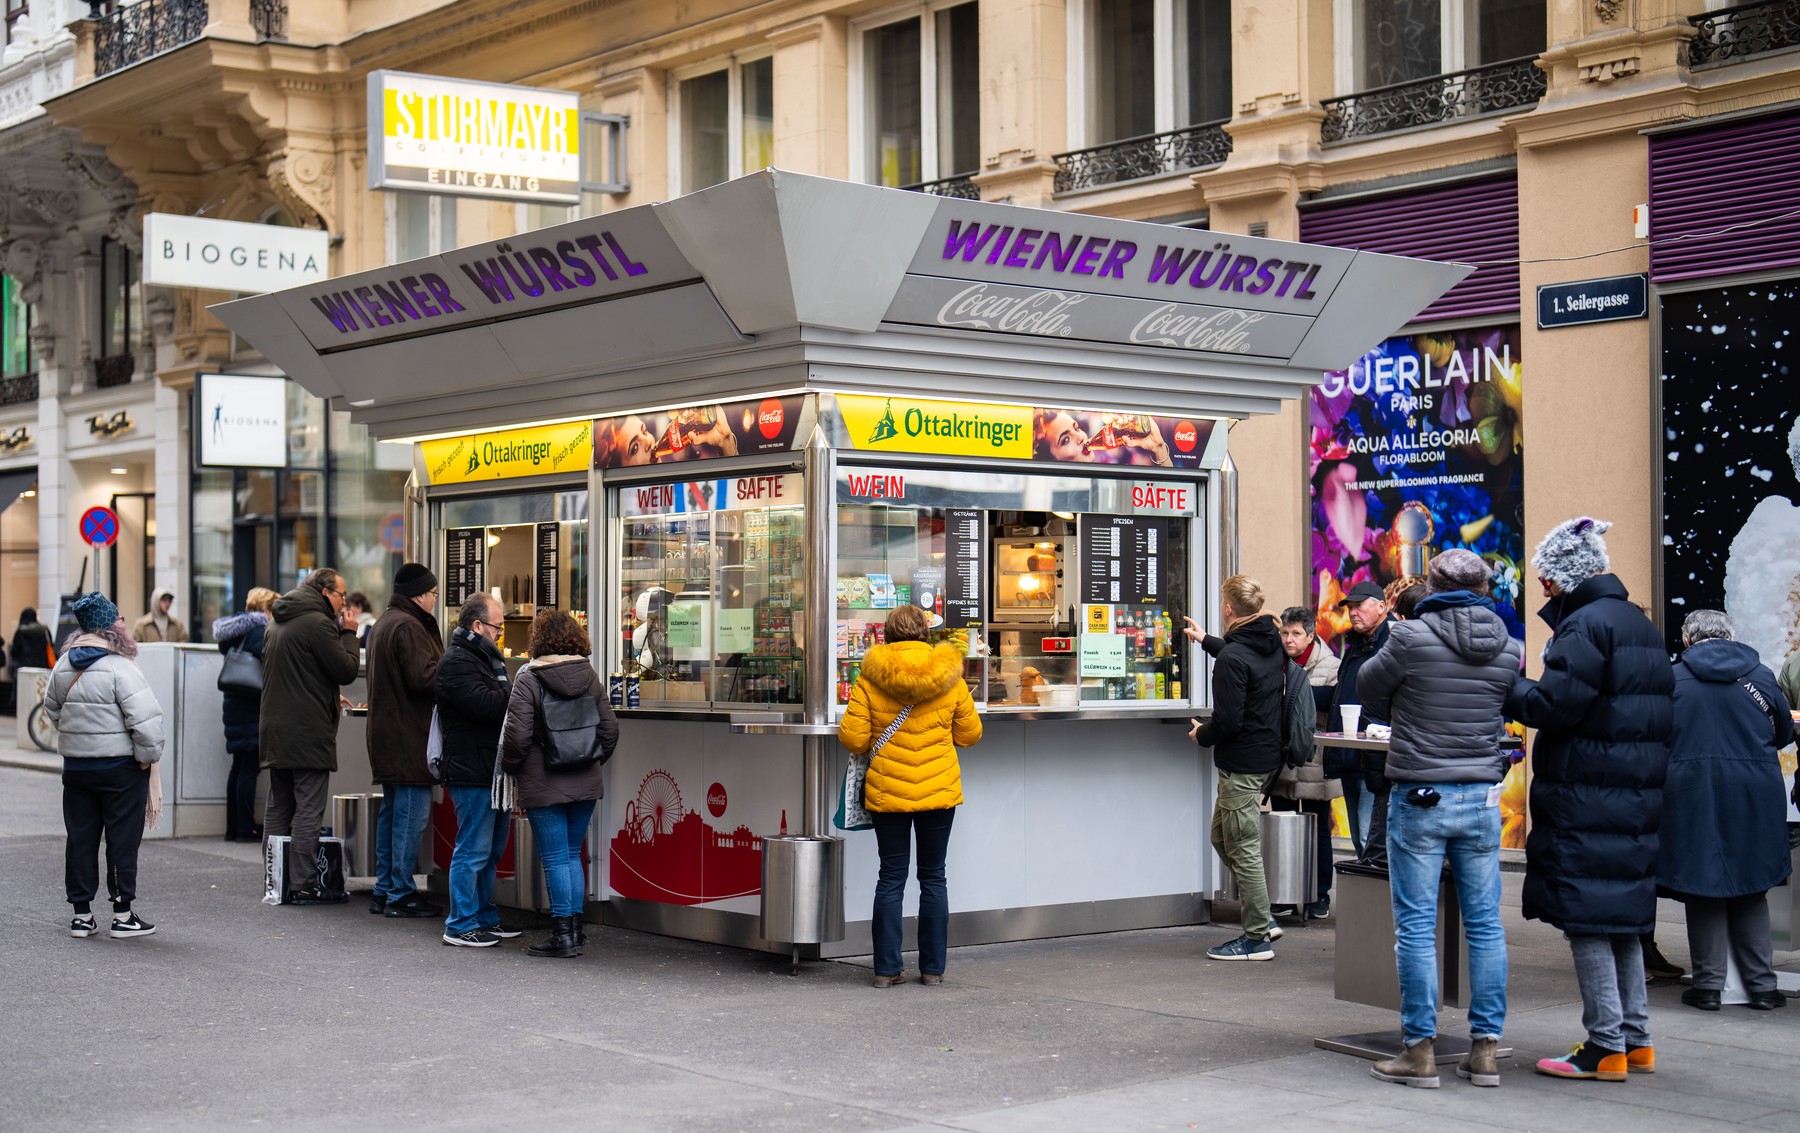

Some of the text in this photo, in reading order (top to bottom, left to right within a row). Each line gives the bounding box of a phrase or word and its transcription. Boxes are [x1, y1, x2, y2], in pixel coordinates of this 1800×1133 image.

[396, 90, 568, 154] STURMAYR
[428, 169, 540, 192] EINGANG
[164, 240, 318, 273] BIOGENA
[942, 218, 1322, 300] WIENER WÜRSTL
[310, 231, 648, 333] WIENER WÜRSTL
[1566, 292, 1629, 312] Seilergasse
[1320, 344, 1511, 398] GUERLAIN
[1390, 394, 1433, 412] PARIS
[904, 407, 1023, 446] Ottakringer
[1347, 428, 1481, 454] AQUA ALLEGORIA
[483, 439, 552, 468] Ottakringer
[1379, 450, 1446, 465] FLORABLOOM
[849, 474, 1187, 510] WEIN SÄFTE
[1345, 473, 1485, 491] THE NEW SUPERBLOOMING FRAGRANCE
[636, 486, 674, 508] WEIN
